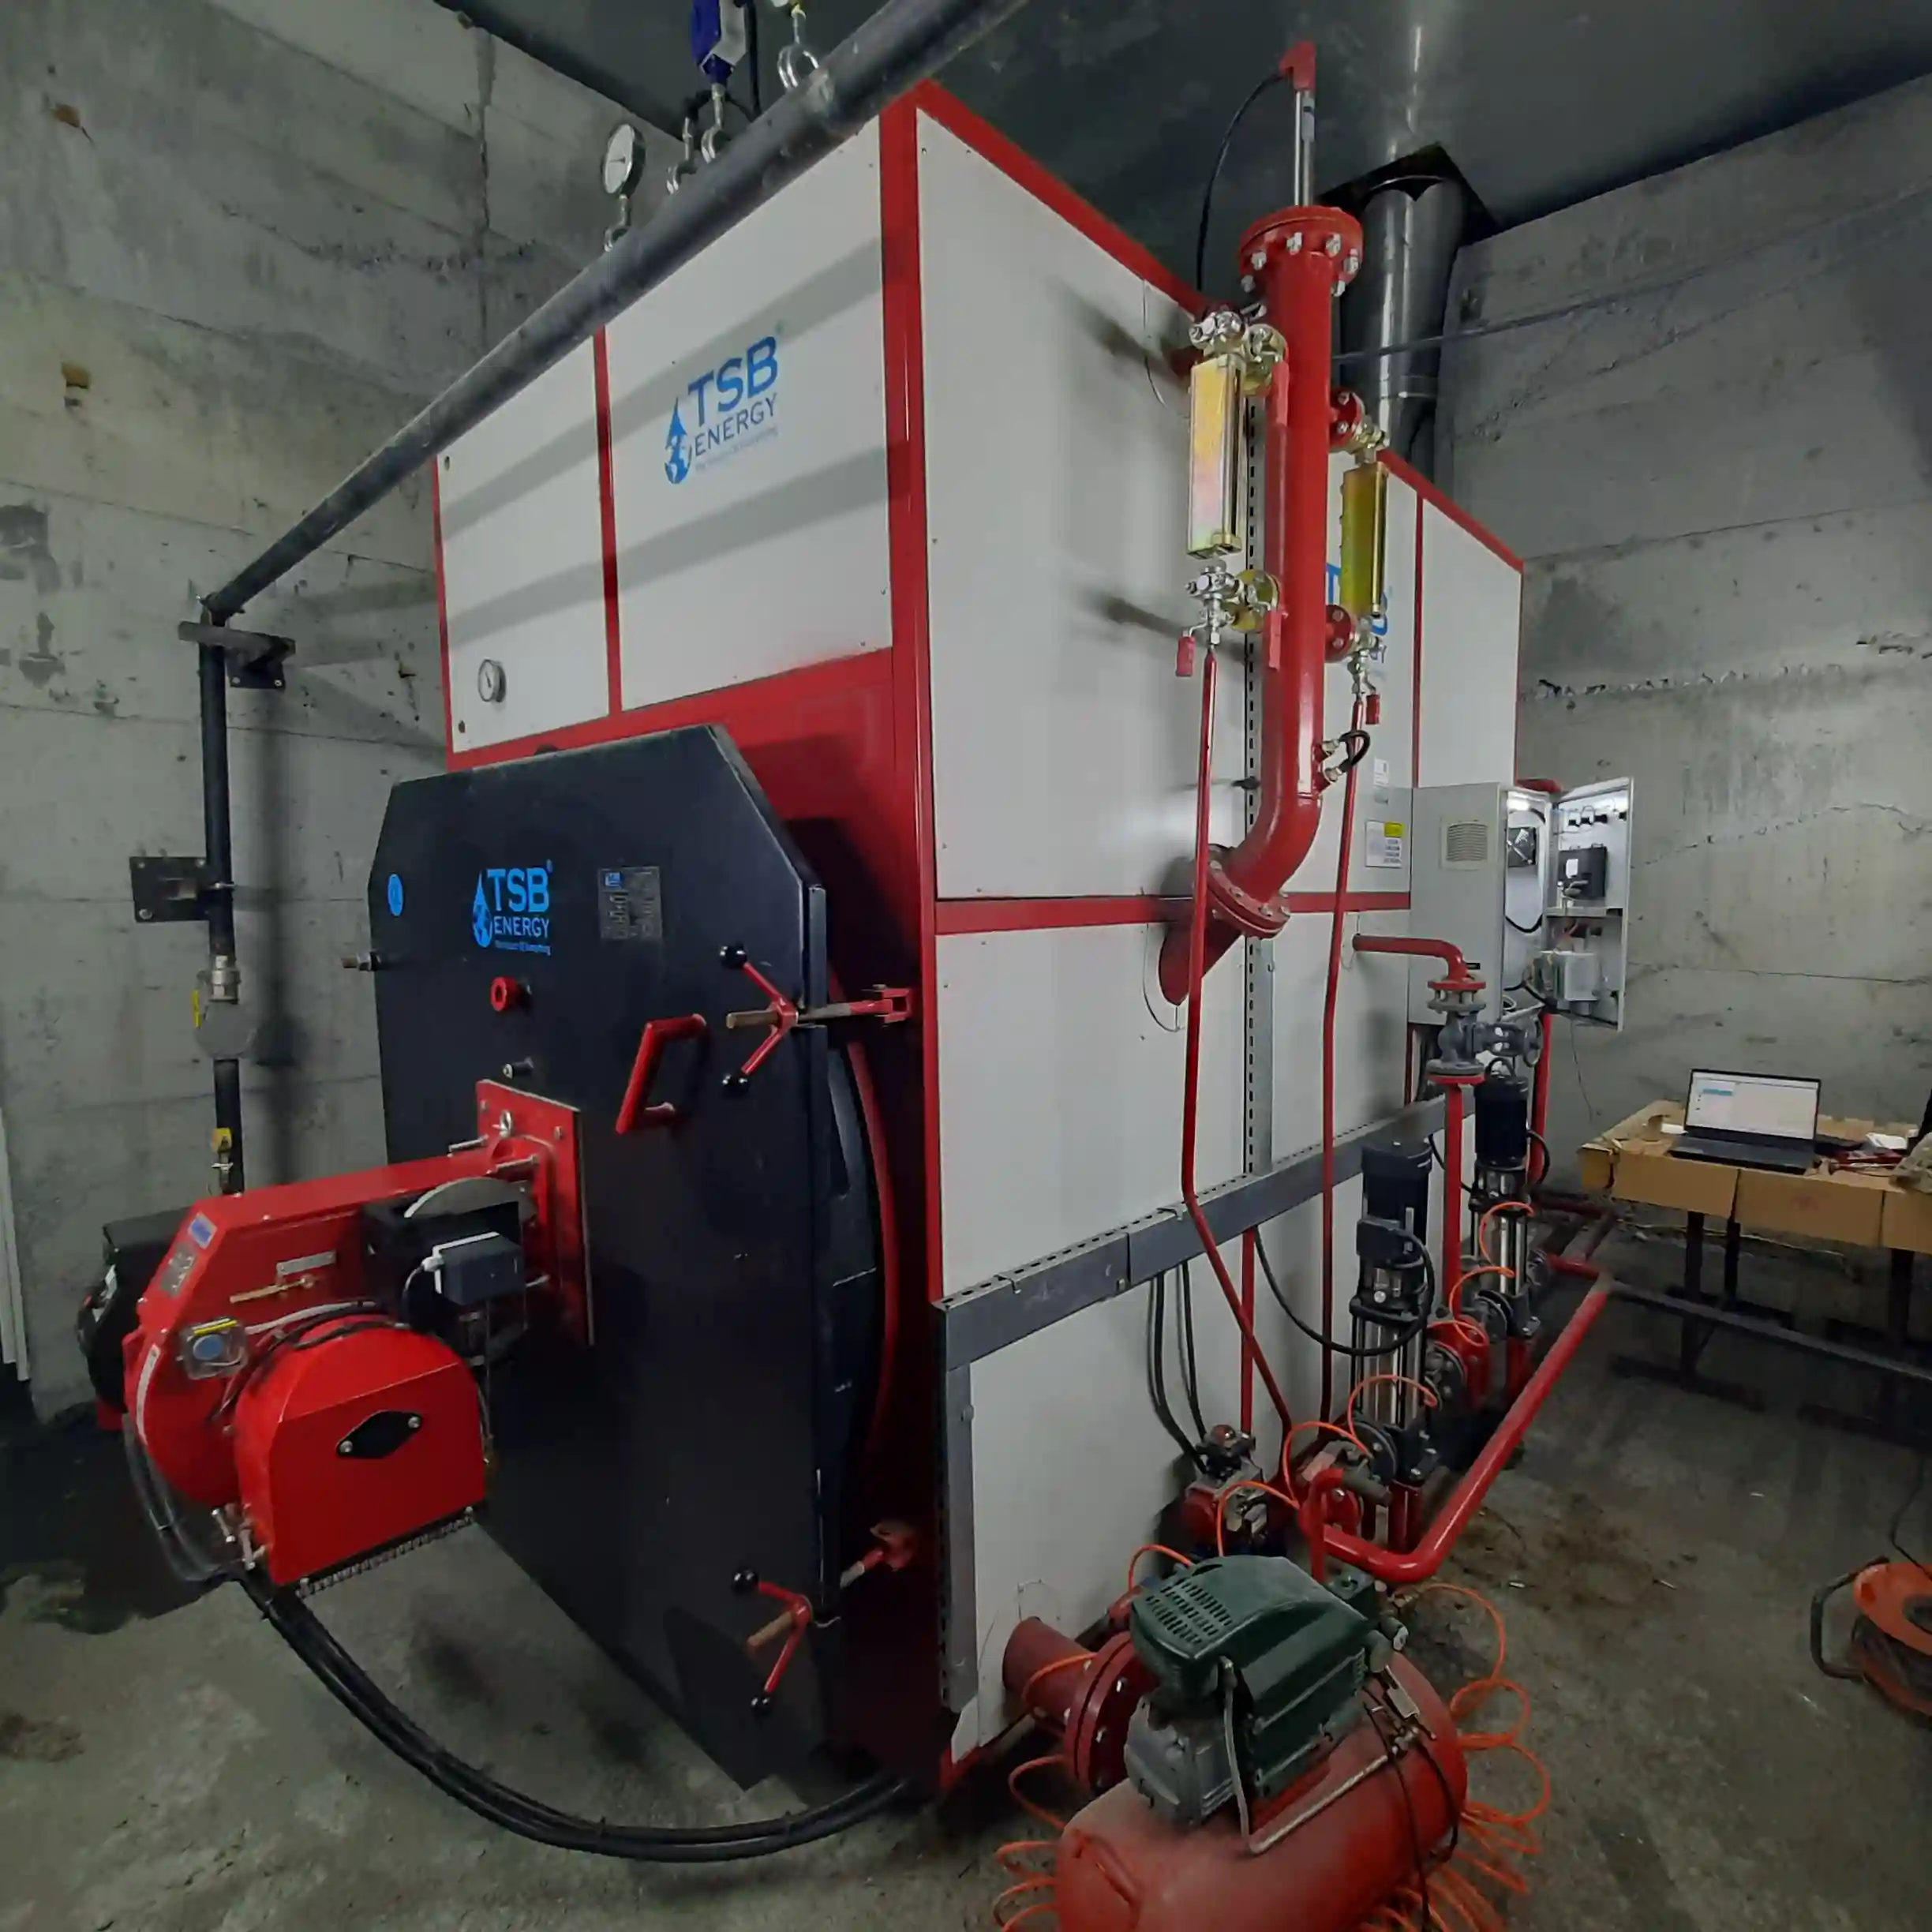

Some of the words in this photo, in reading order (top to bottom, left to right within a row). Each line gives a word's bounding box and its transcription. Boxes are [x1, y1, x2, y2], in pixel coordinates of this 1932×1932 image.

[687, 336, 778, 427] TSB
[695, 392, 777, 456] ENERGY
[487, 867, 549, 912] TSB
[493, 915, 550, 939] ENERGY
